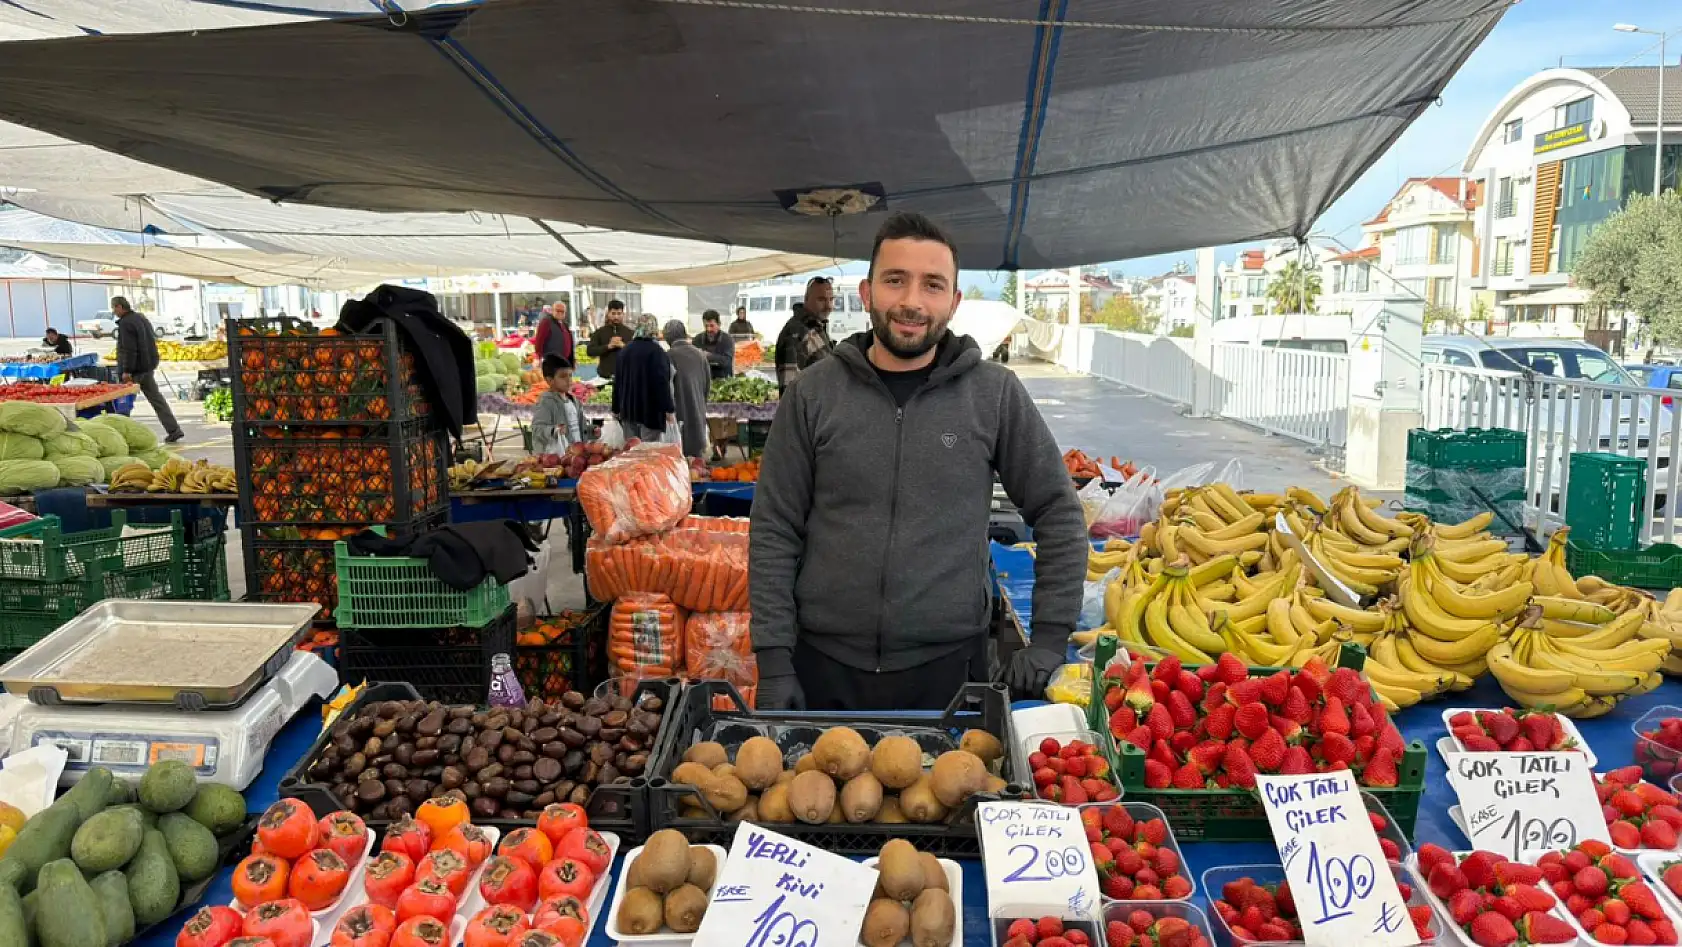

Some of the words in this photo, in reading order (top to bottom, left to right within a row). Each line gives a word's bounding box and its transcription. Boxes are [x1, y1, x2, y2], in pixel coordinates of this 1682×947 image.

[1458, 757, 1502, 780] ÇOK
[1511, 754, 1571, 774] TATLI
[1265, 782, 1302, 809] ÇOK
[1304, 777, 1349, 799] TATLI
[982, 806, 1021, 824] ÇOK
[1028, 807, 1070, 821] TATLI
[1002, 844, 1085, 883] 200
[1306, 841, 1375, 924] 100
